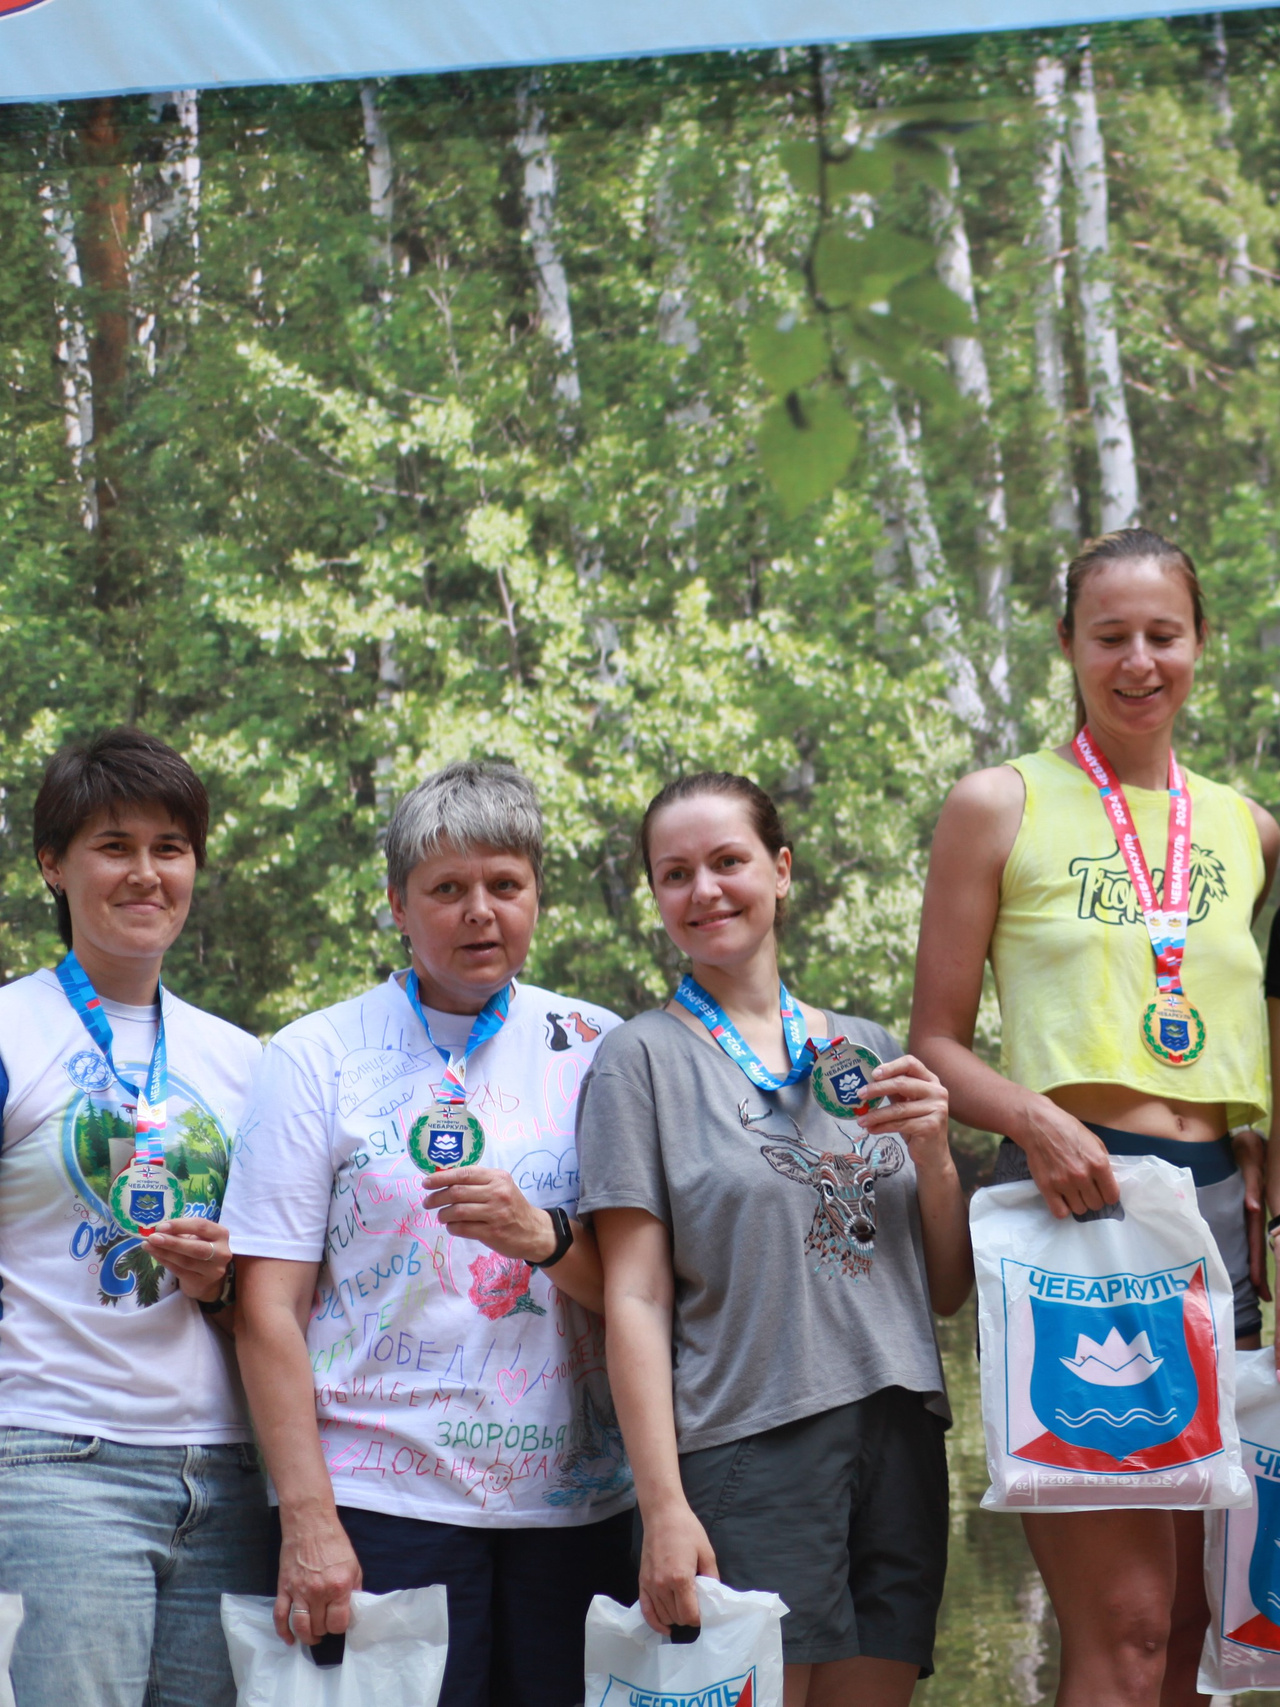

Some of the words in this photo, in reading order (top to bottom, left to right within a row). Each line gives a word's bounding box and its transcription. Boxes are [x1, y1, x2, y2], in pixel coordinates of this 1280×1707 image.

[722, 1030, 747, 1057] 2024
[824, 1058, 862, 1077] ЧЕБАРКУЛЬ
[427, 1123, 469, 1131] ЧЕБАРКУЛЬ
[127, 1183, 169, 1191] ЧЕБАРКУЛЬ
[1028, 1270, 1190, 1303] ЧЕБАРКУЛЬ
